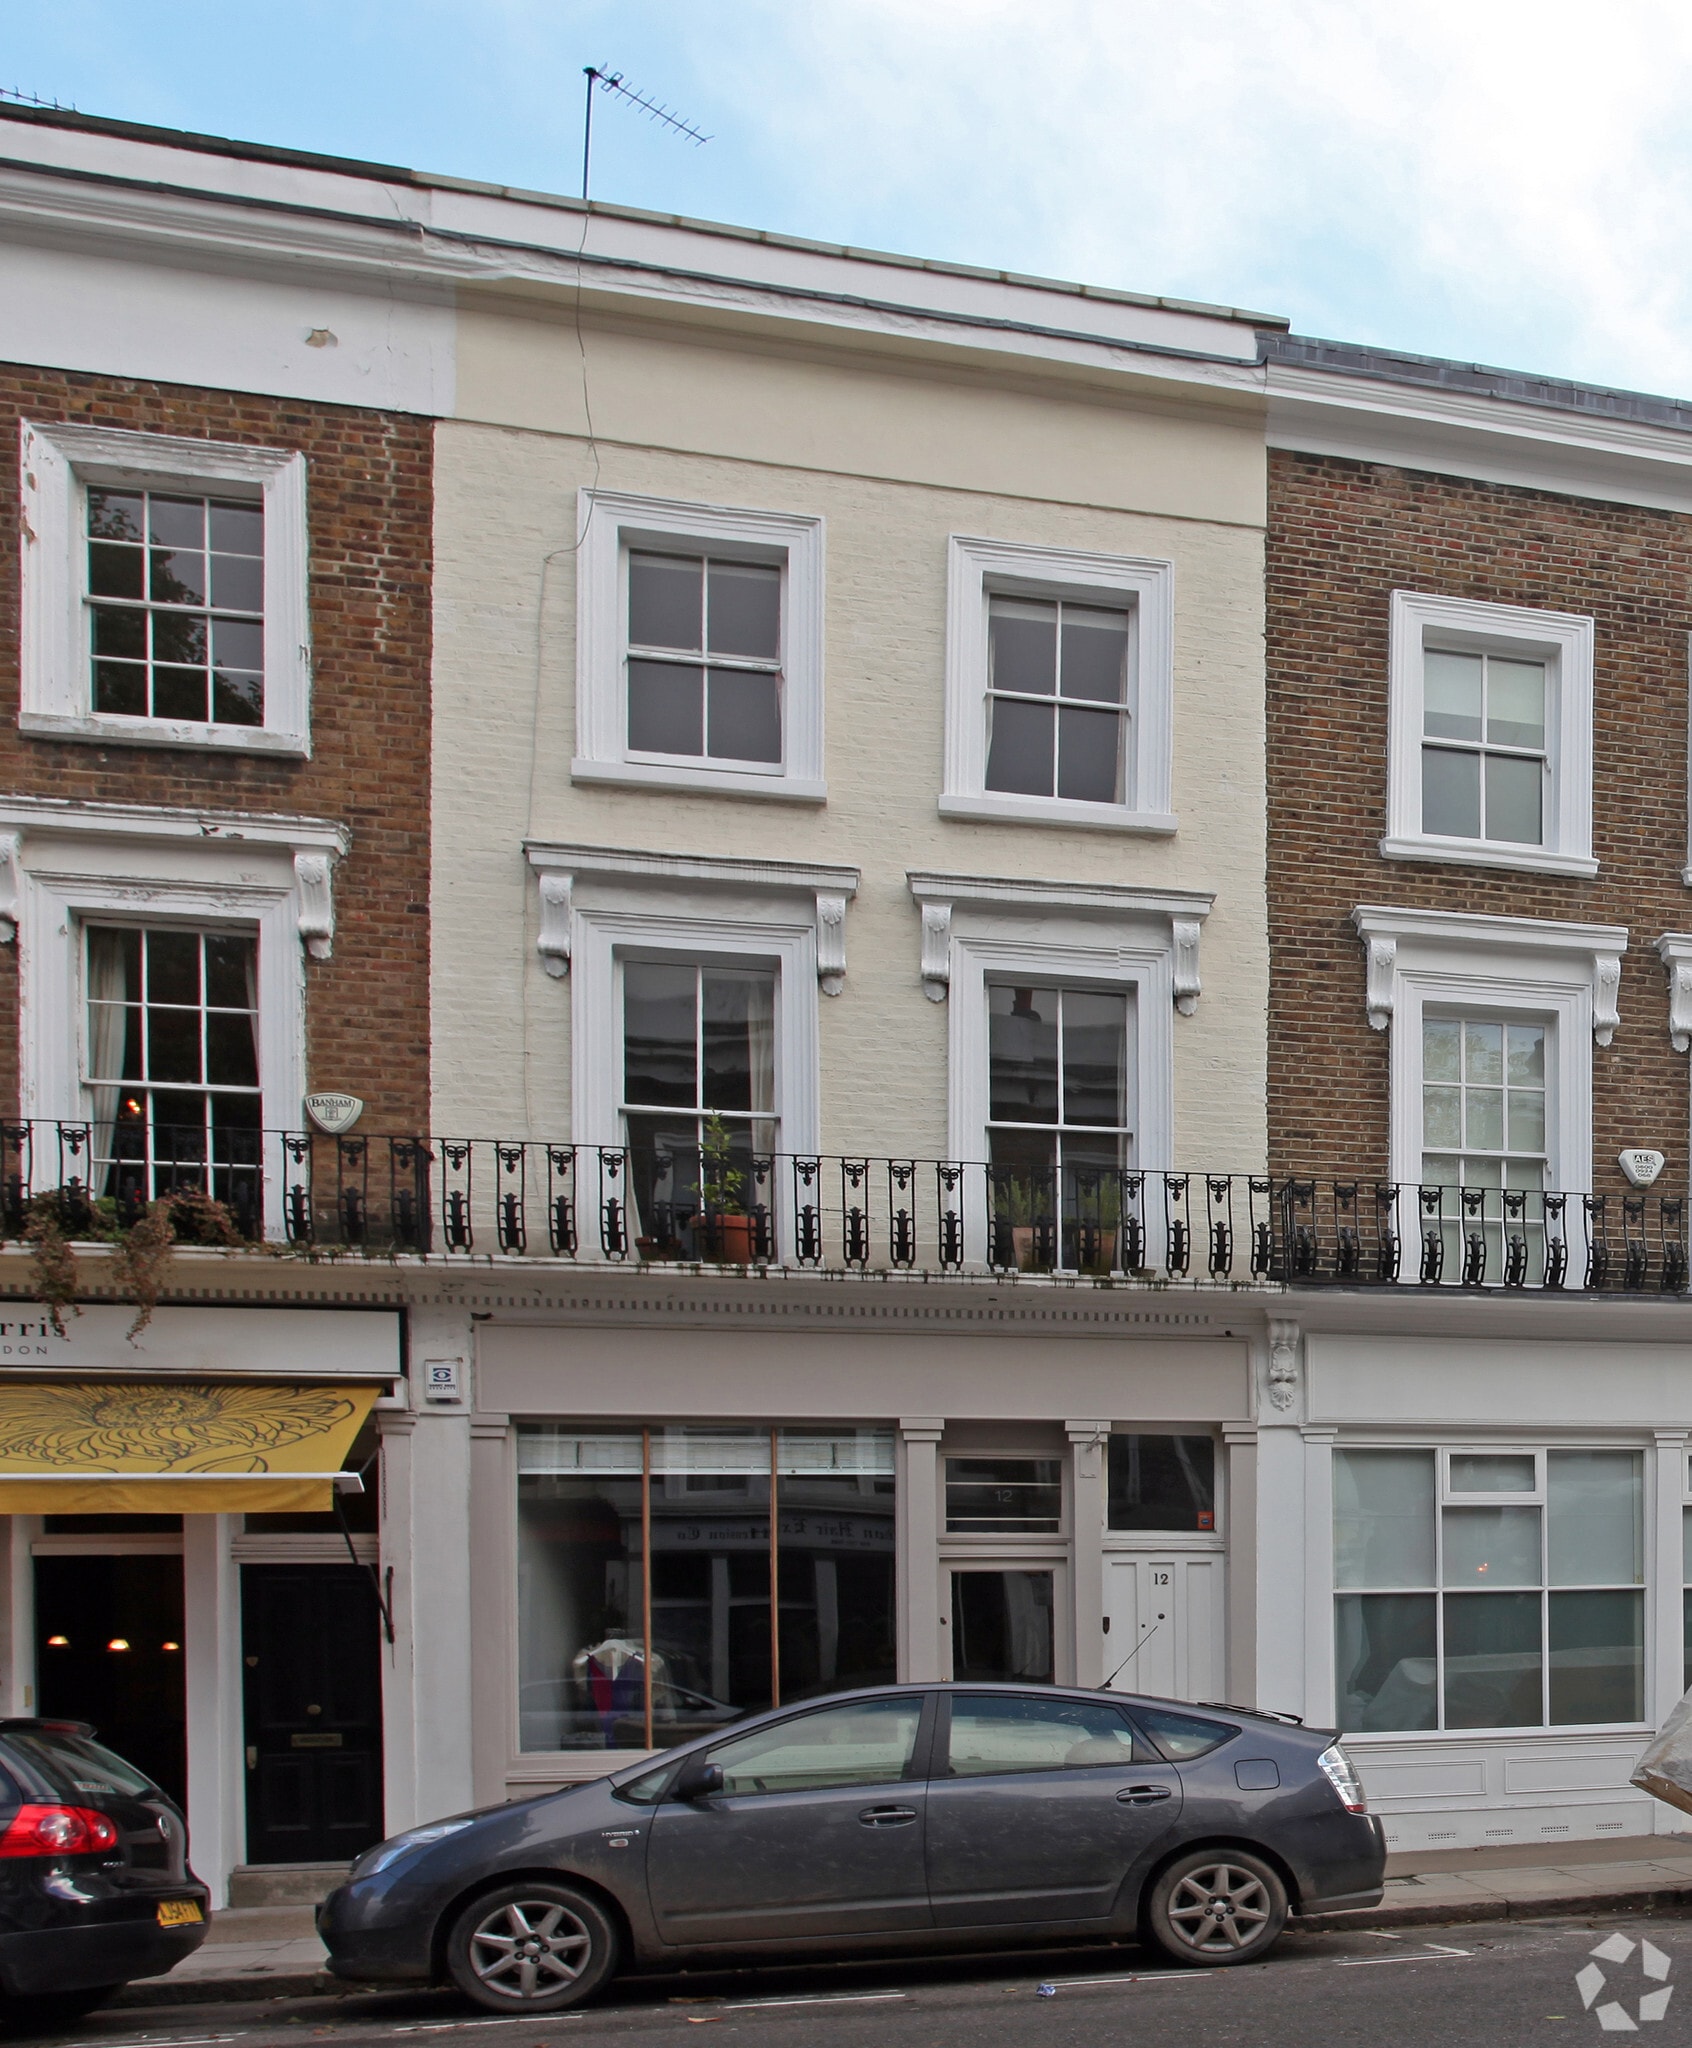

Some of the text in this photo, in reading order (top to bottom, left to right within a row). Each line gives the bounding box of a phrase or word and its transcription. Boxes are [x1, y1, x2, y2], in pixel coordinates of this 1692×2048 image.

[311, 1098, 352, 1107] BANHAM
[1634, 1155, 1654, 1163] AES
[995, 1489, 1013, 1502] 12
[1154, 1572, 1169, 1585] 12
